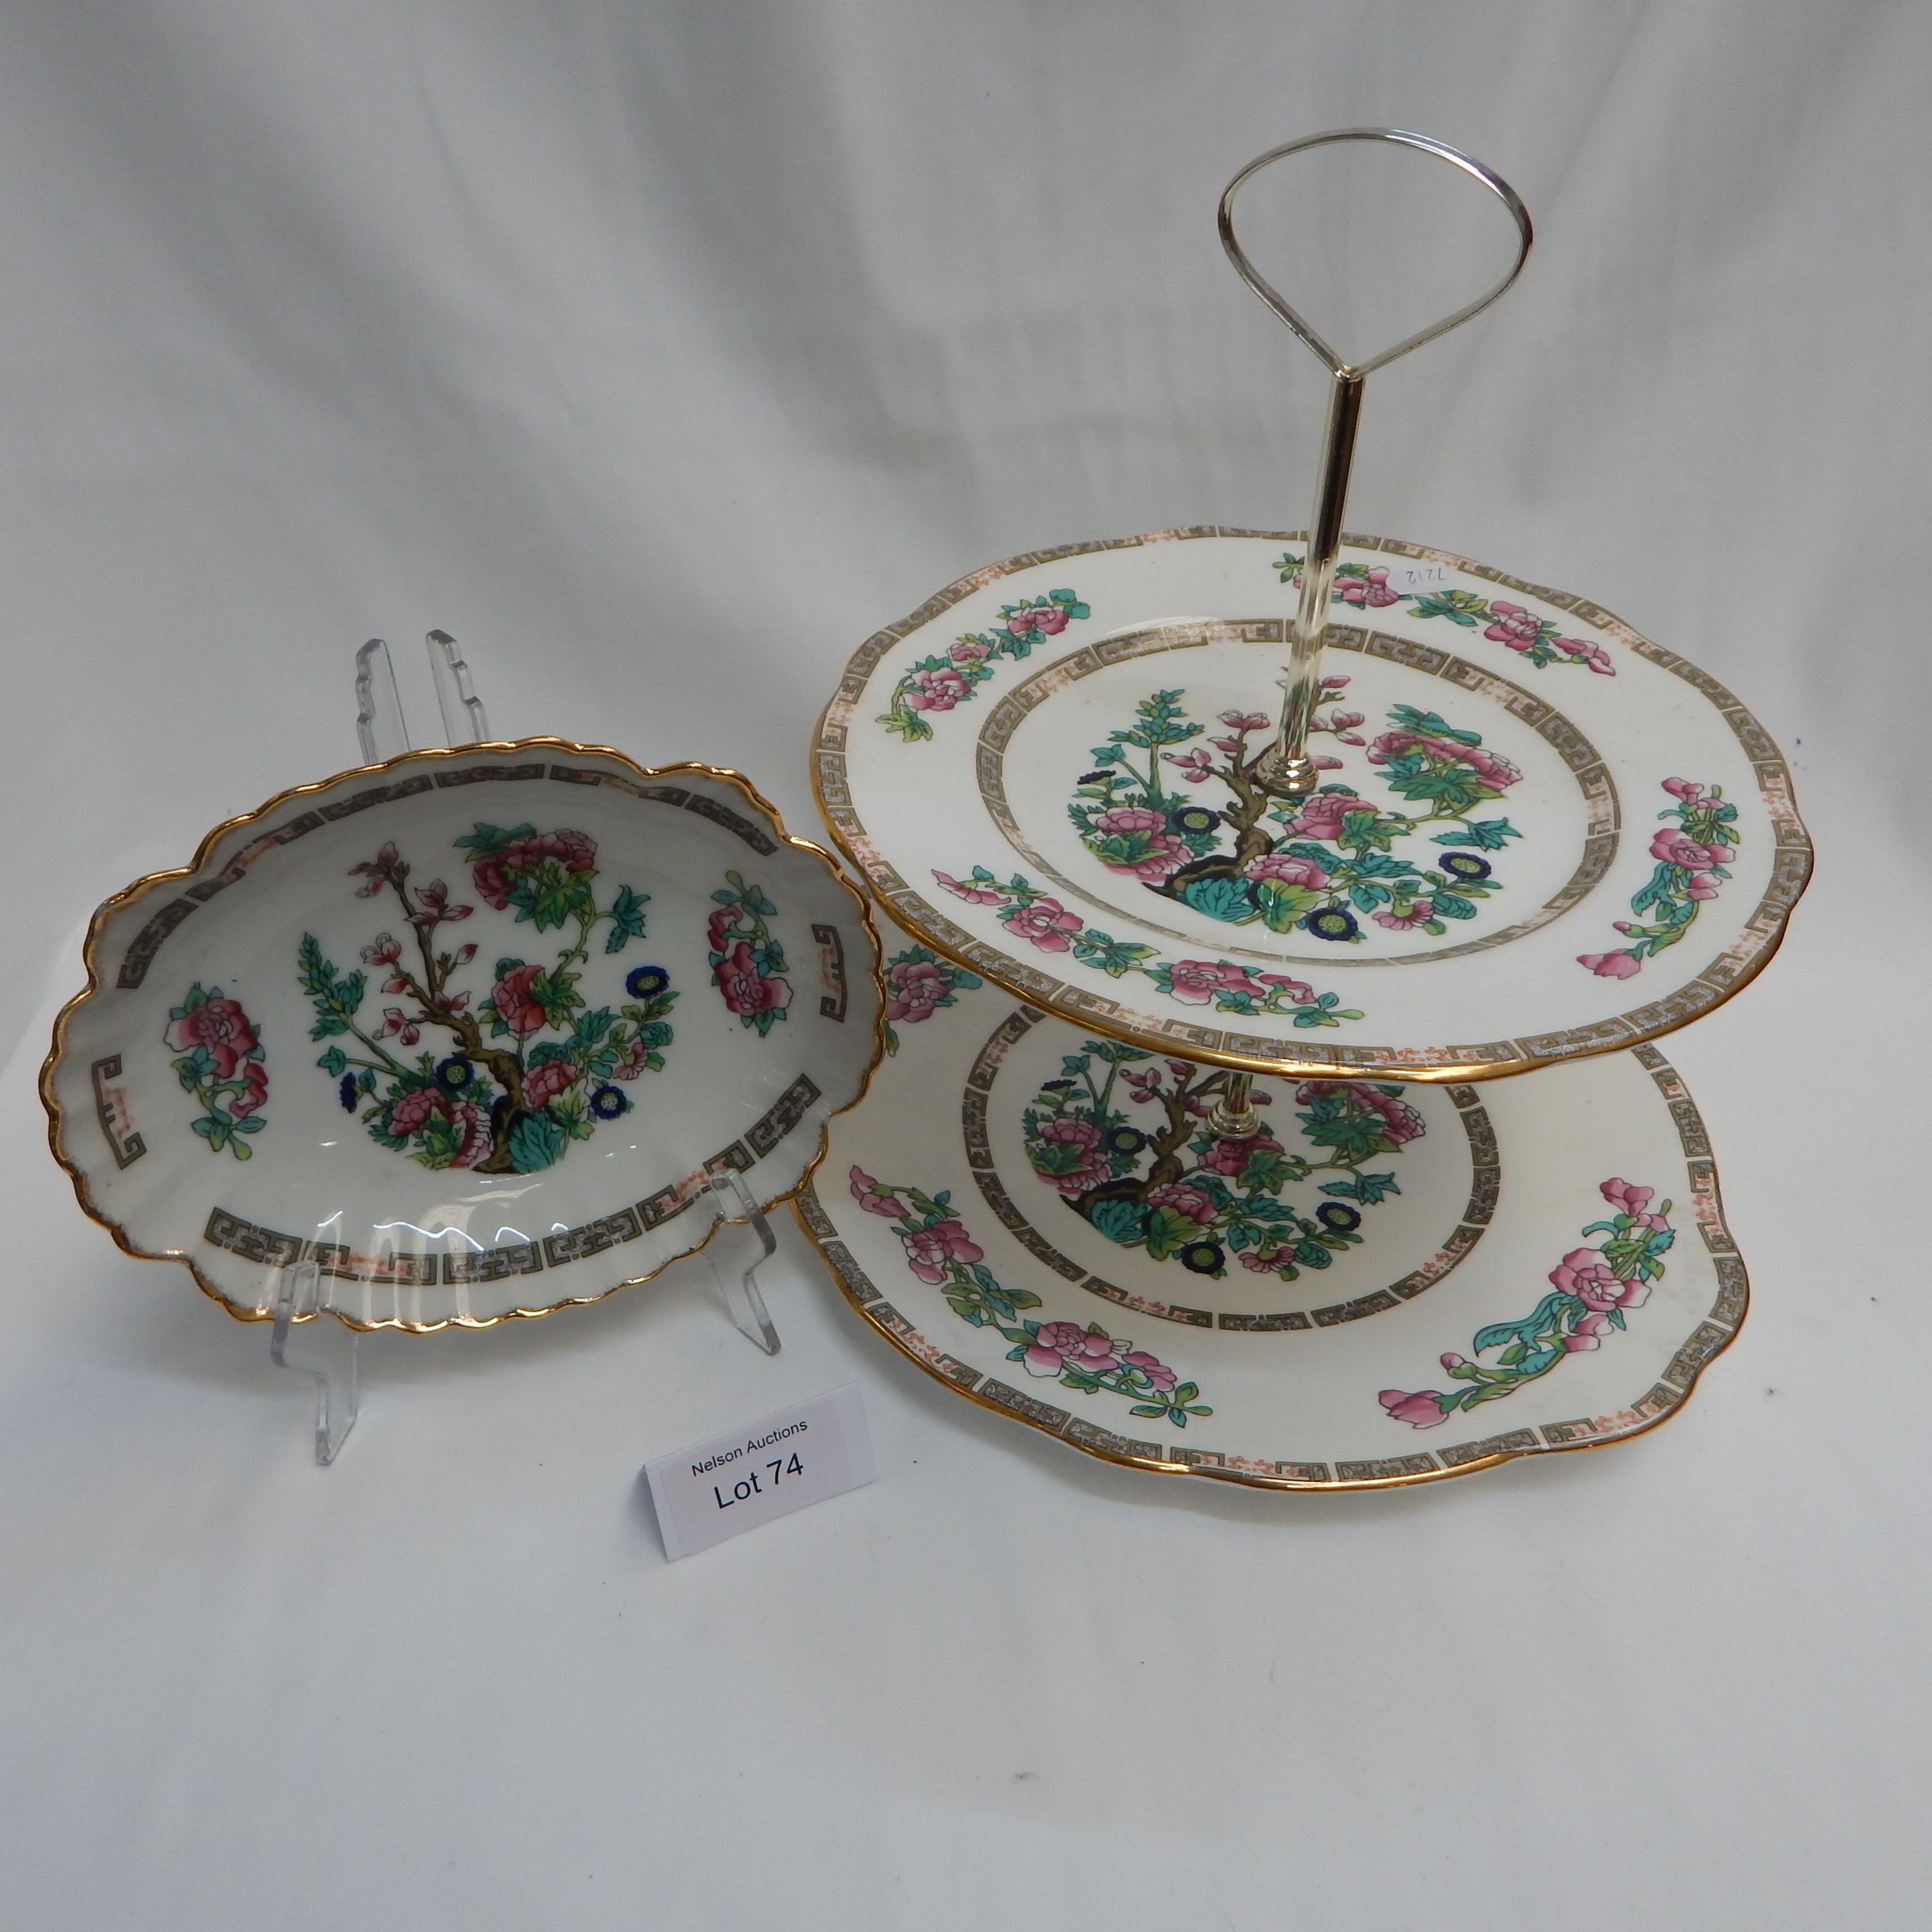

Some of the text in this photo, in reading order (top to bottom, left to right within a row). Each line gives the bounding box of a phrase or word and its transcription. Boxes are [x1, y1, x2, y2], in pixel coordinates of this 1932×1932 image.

[692, 1420, 808, 1477] Nelson Auctions
[713, 1452, 804, 1509] Lot 74
